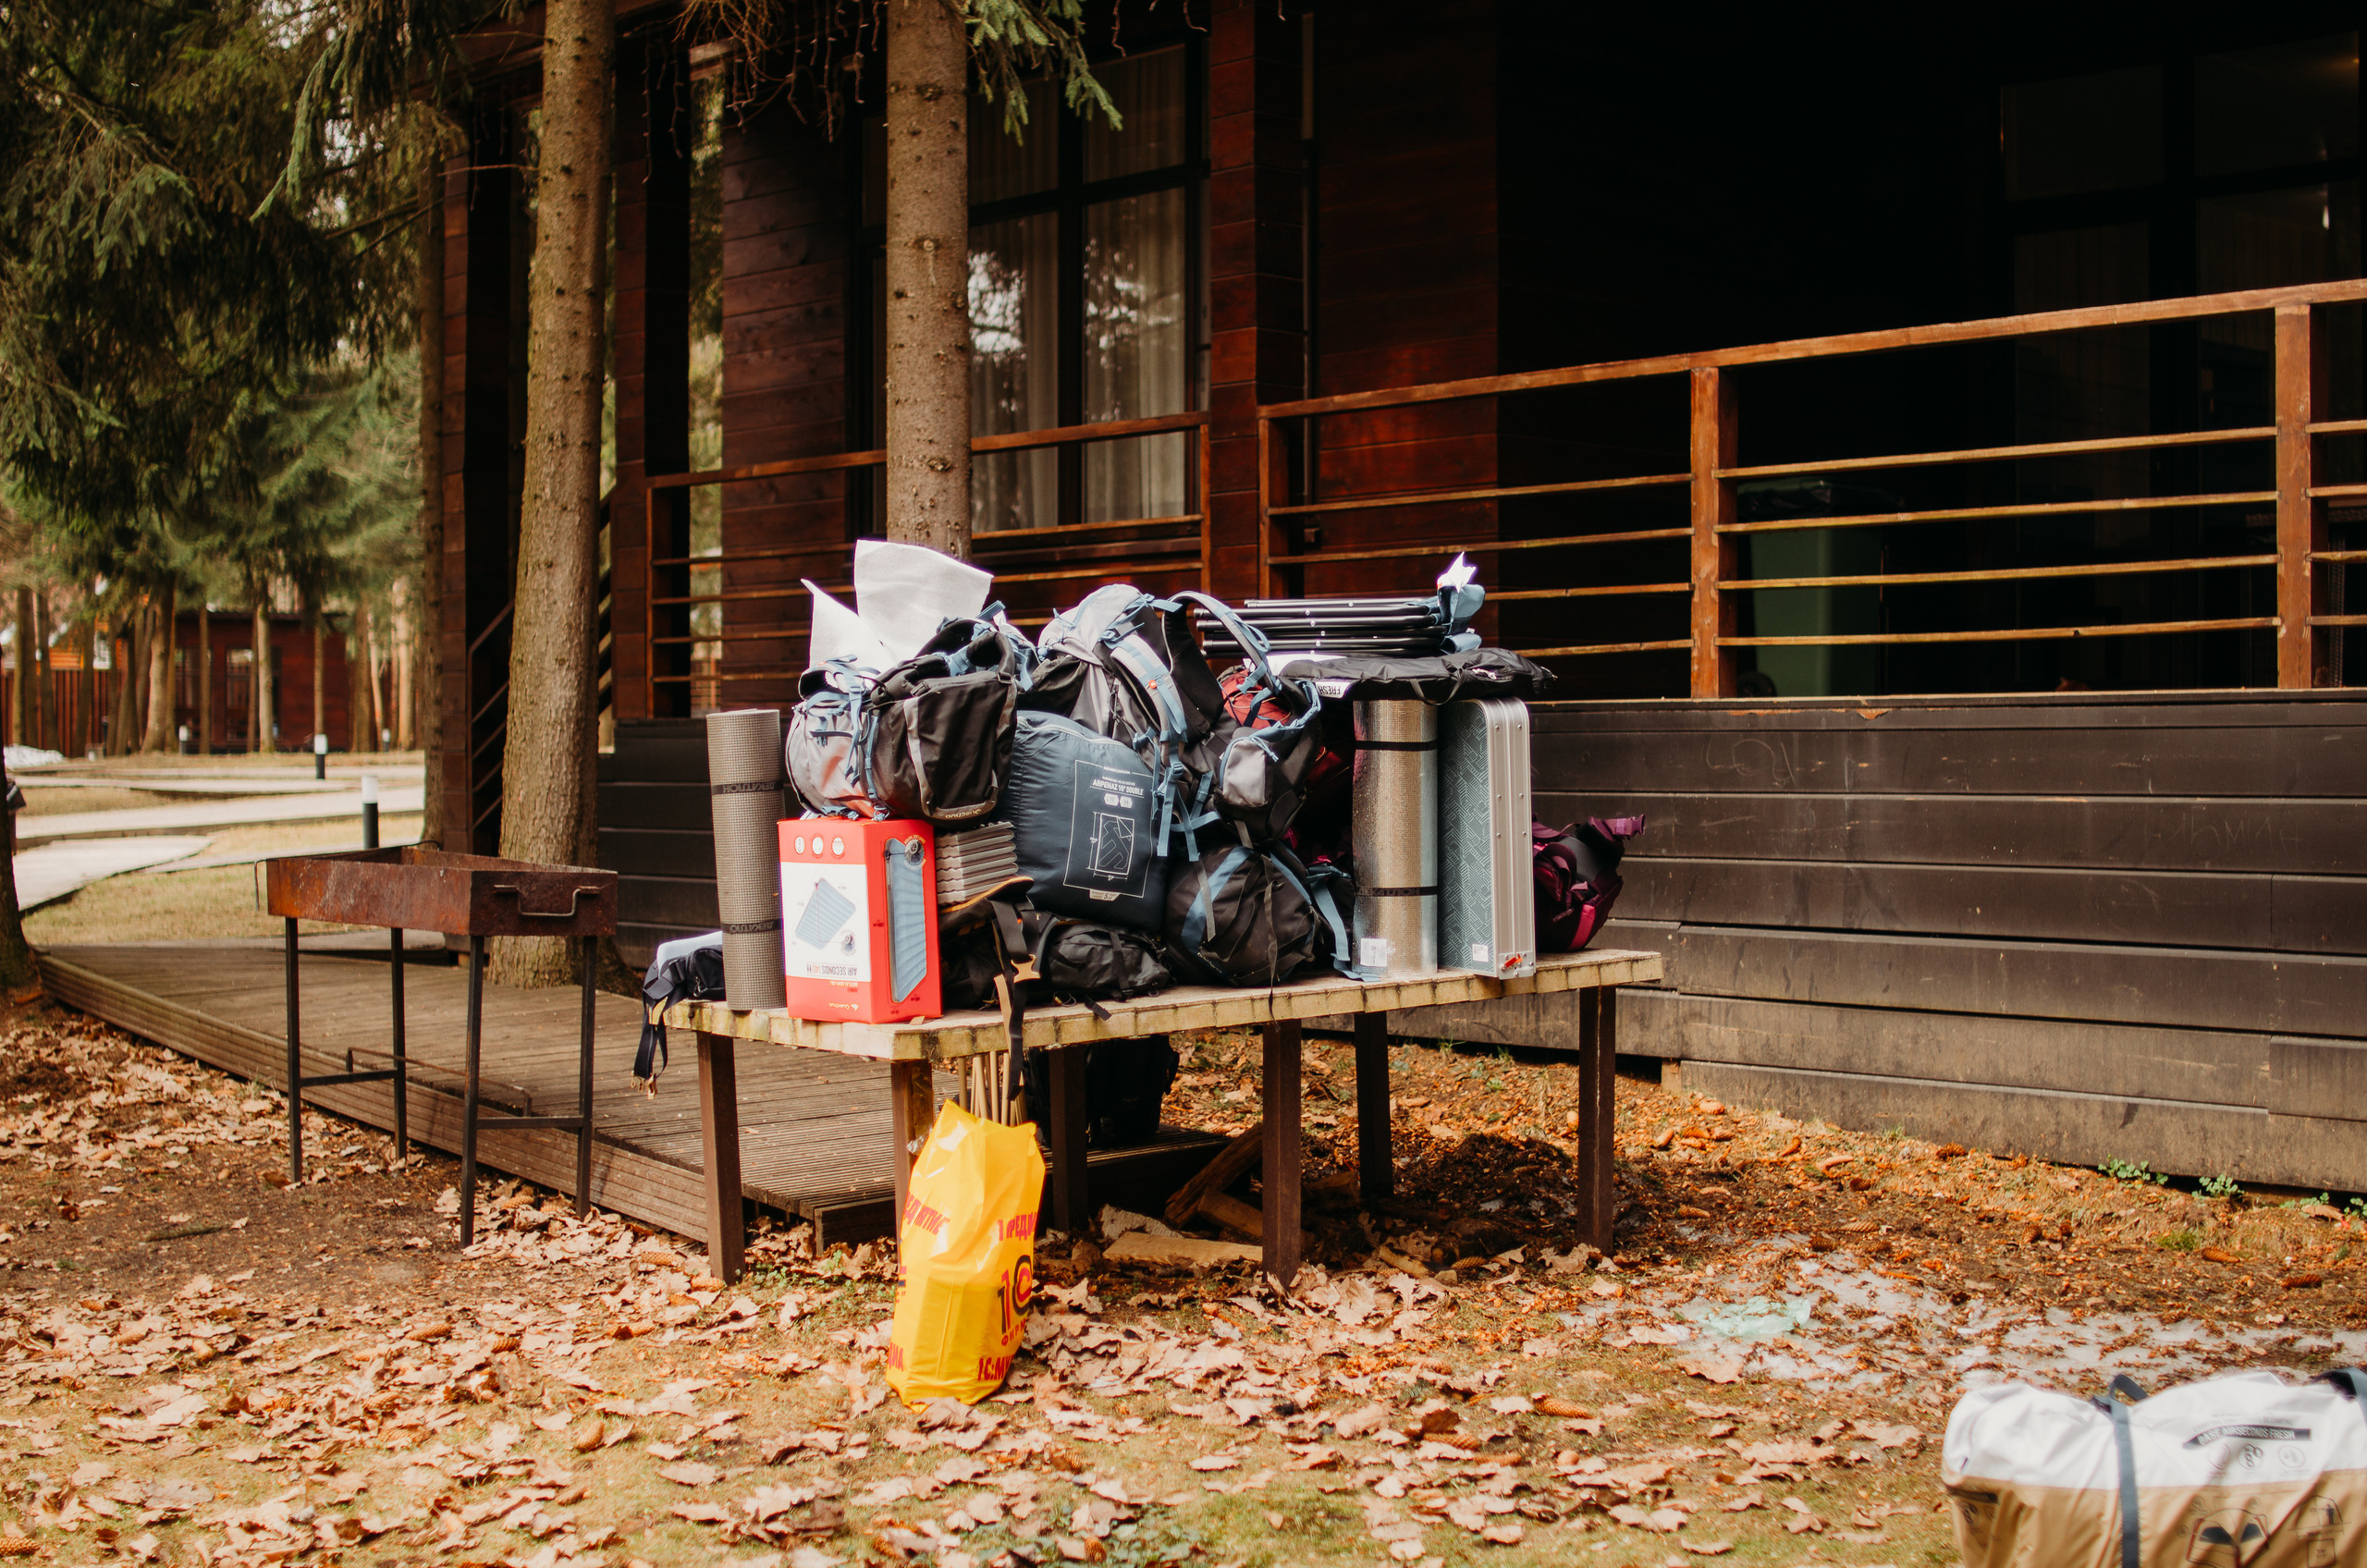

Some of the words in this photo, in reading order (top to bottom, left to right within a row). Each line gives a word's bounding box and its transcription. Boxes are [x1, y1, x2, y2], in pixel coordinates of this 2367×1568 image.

[1318, 685, 1341, 695] FRESH
[722, 781, 776, 793] ДЕКАТЛОН
[1092, 778, 1118, 790] ARPENAZ
[1126, 786, 1145, 796] DOUBLE
[821, 964, 847, 976] SECONDS
[847, 966, 858, 976] AIR
[2197, 1429, 2223, 1446] BASE
[2223, 1427, 2269, 1439] AIRSECONDS
[2269, 1428, 2297, 1439] FRESH
